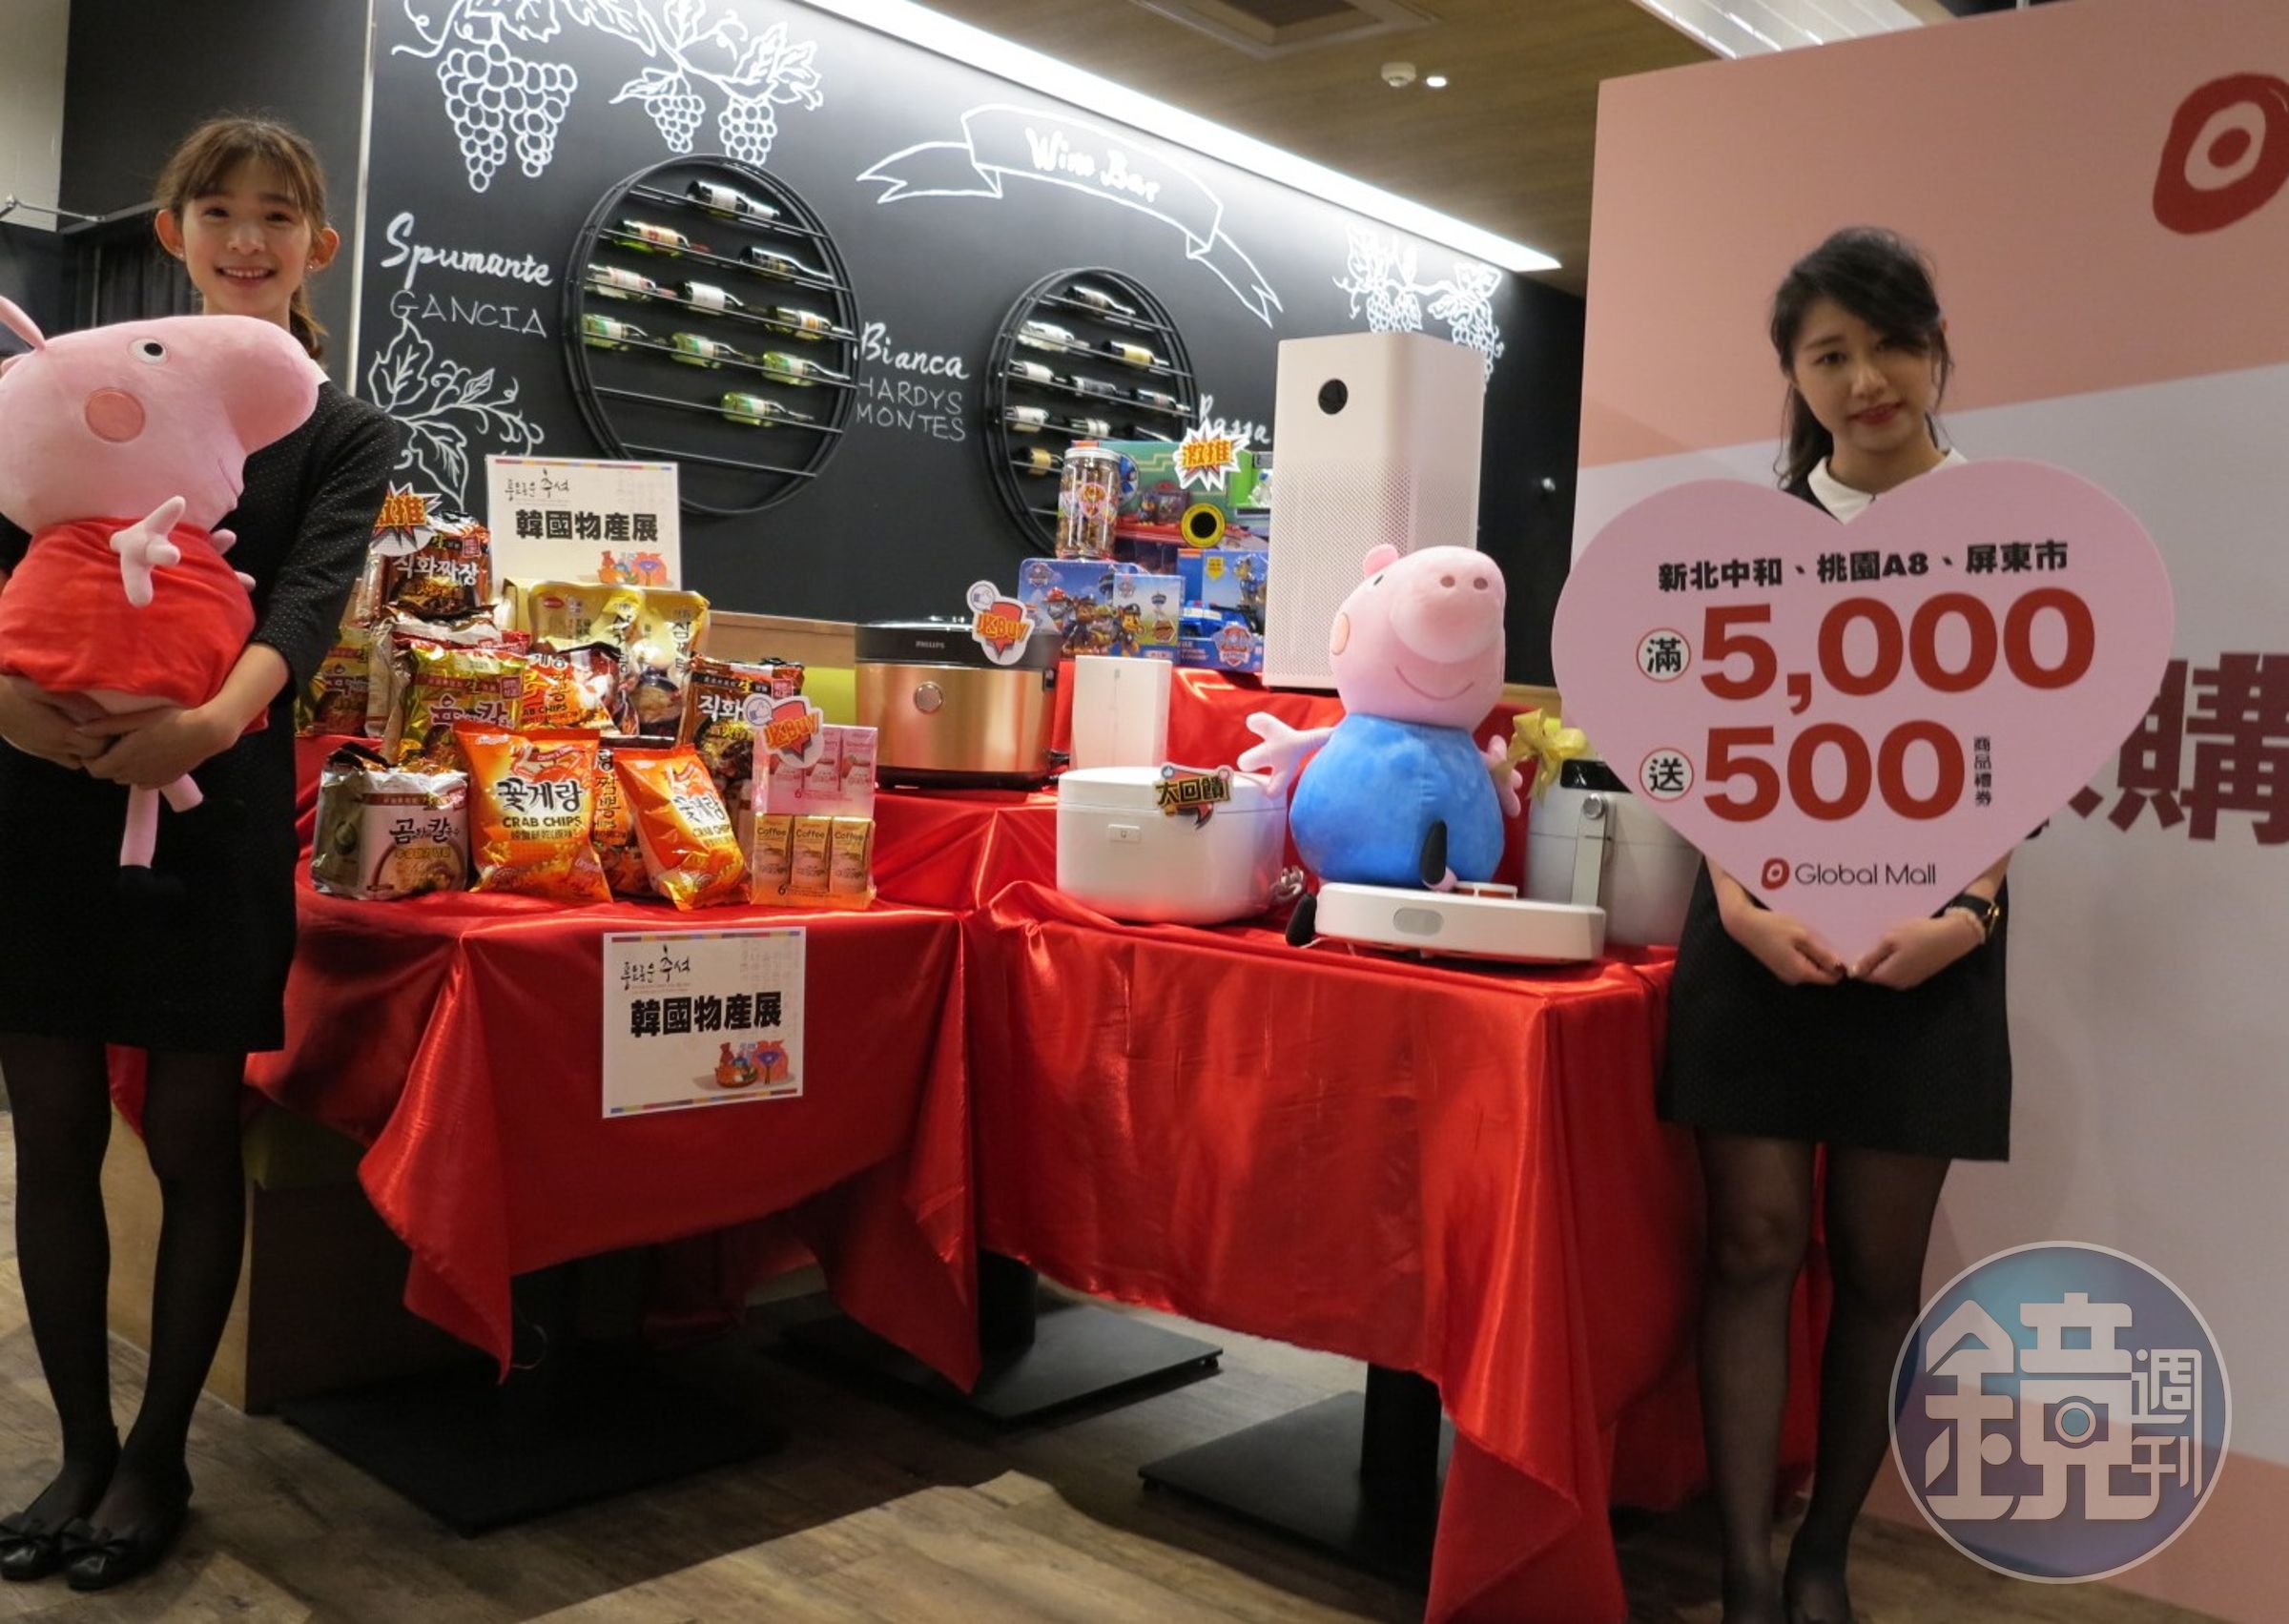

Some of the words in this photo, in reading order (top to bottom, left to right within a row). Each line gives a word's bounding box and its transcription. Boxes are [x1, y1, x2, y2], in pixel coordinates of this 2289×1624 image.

[1100, 149, 1161, 202] Bar
[381, 212, 553, 290] Spumante
[390, 290, 546, 338] GANCIA
[860, 321, 970, 380] Bianca
[857, 377, 962, 415] HARDYS
[856, 403, 966, 442] MONTES
[516, 509, 658, 542] 韓國物產展
[1645, 637, 1682, 674] 滿
[1701, 587, 2095, 715] 5,000
[2068, 652, 2289, 845] 購
[1649, 757, 1685, 792] 送
[1702, 719, 1966, 823] 500
[497, 777, 585, 812] 꽃게랑
[503, 816, 540, 829] CRAB
[543, 816, 583, 828] CHIPS
[757, 827, 788, 837] Coffee
[795, 830, 826, 840] Coffee
[1795, 862, 1878, 886] Global
[1885, 862, 1936, 886] Mall
[630, 991, 782, 1038] 韓國物產展
